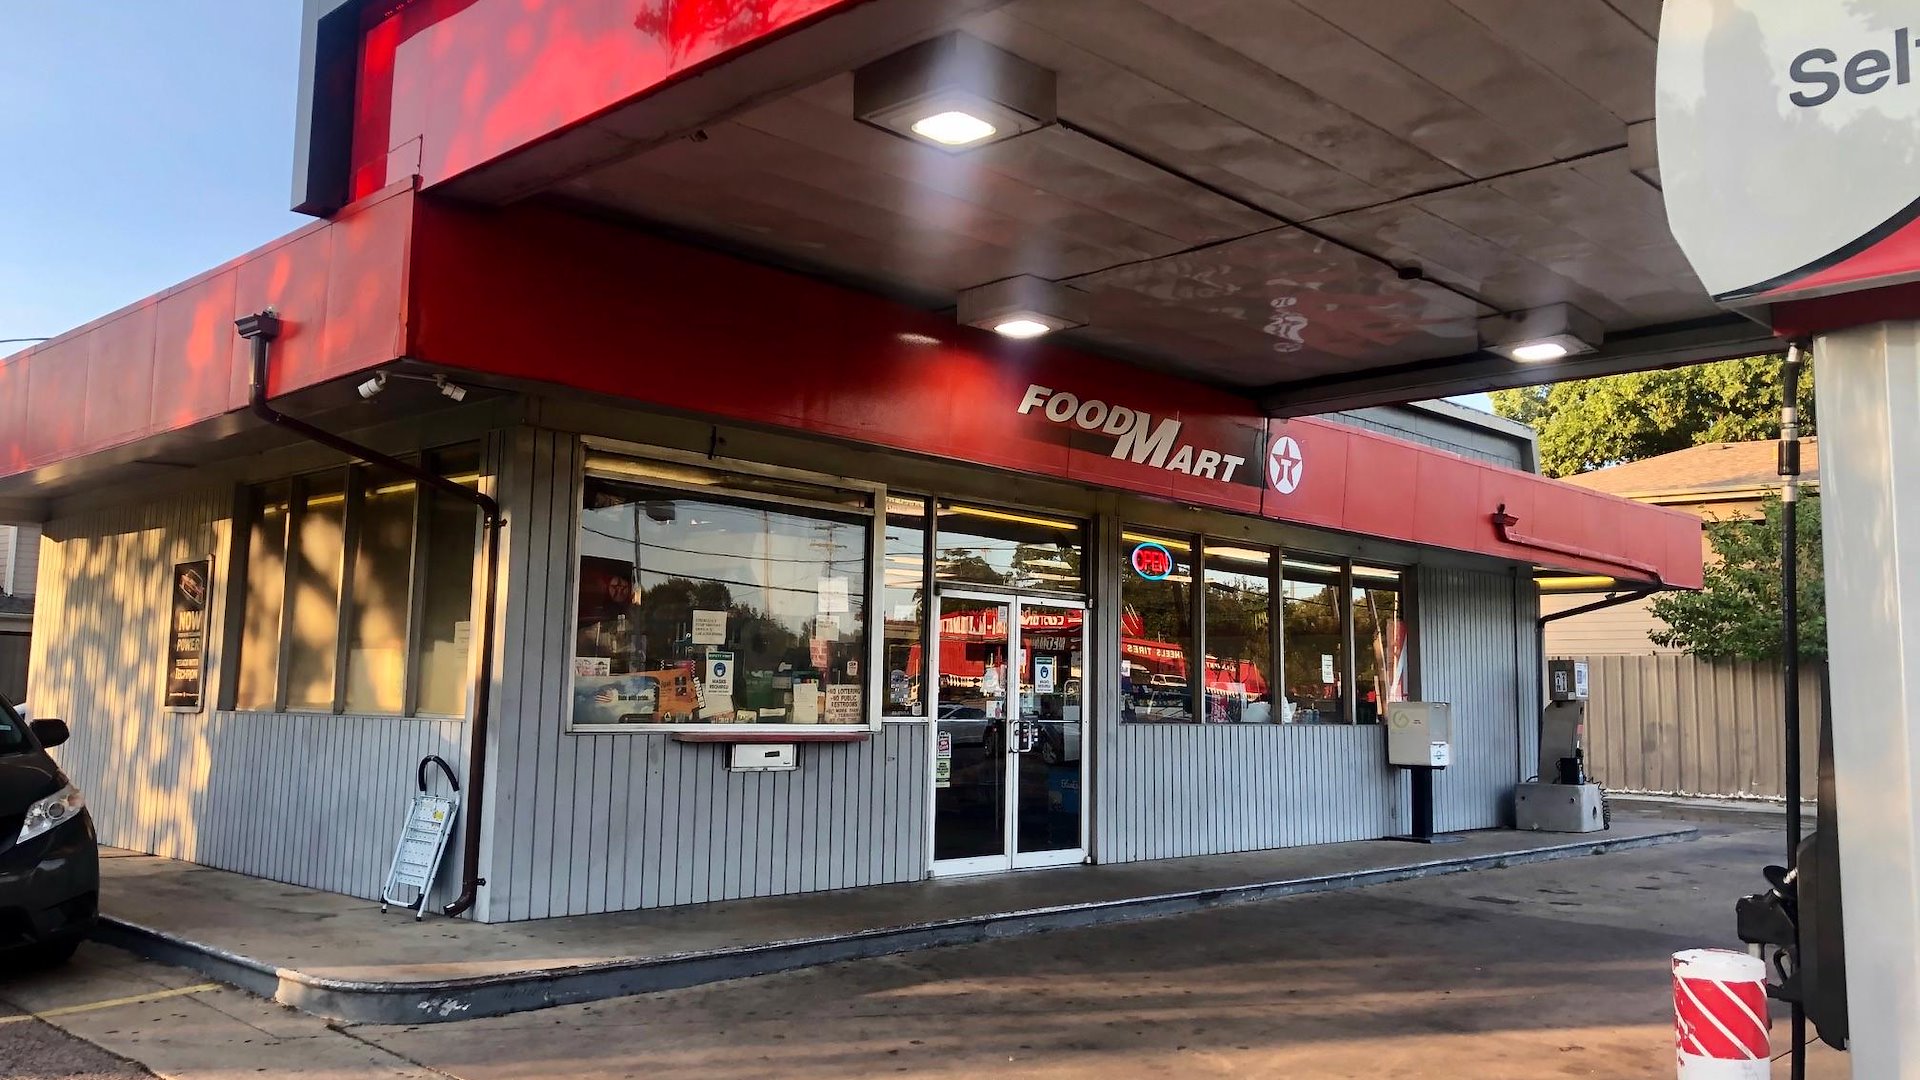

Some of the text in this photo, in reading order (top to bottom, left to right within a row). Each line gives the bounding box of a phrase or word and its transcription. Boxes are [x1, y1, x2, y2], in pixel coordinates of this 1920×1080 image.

[1789, 27, 1920, 107] Sel
[1136, 549, 1169, 573] OPEN
[179, 610, 202, 631] NOW
[177, 638, 200, 651] POWER
